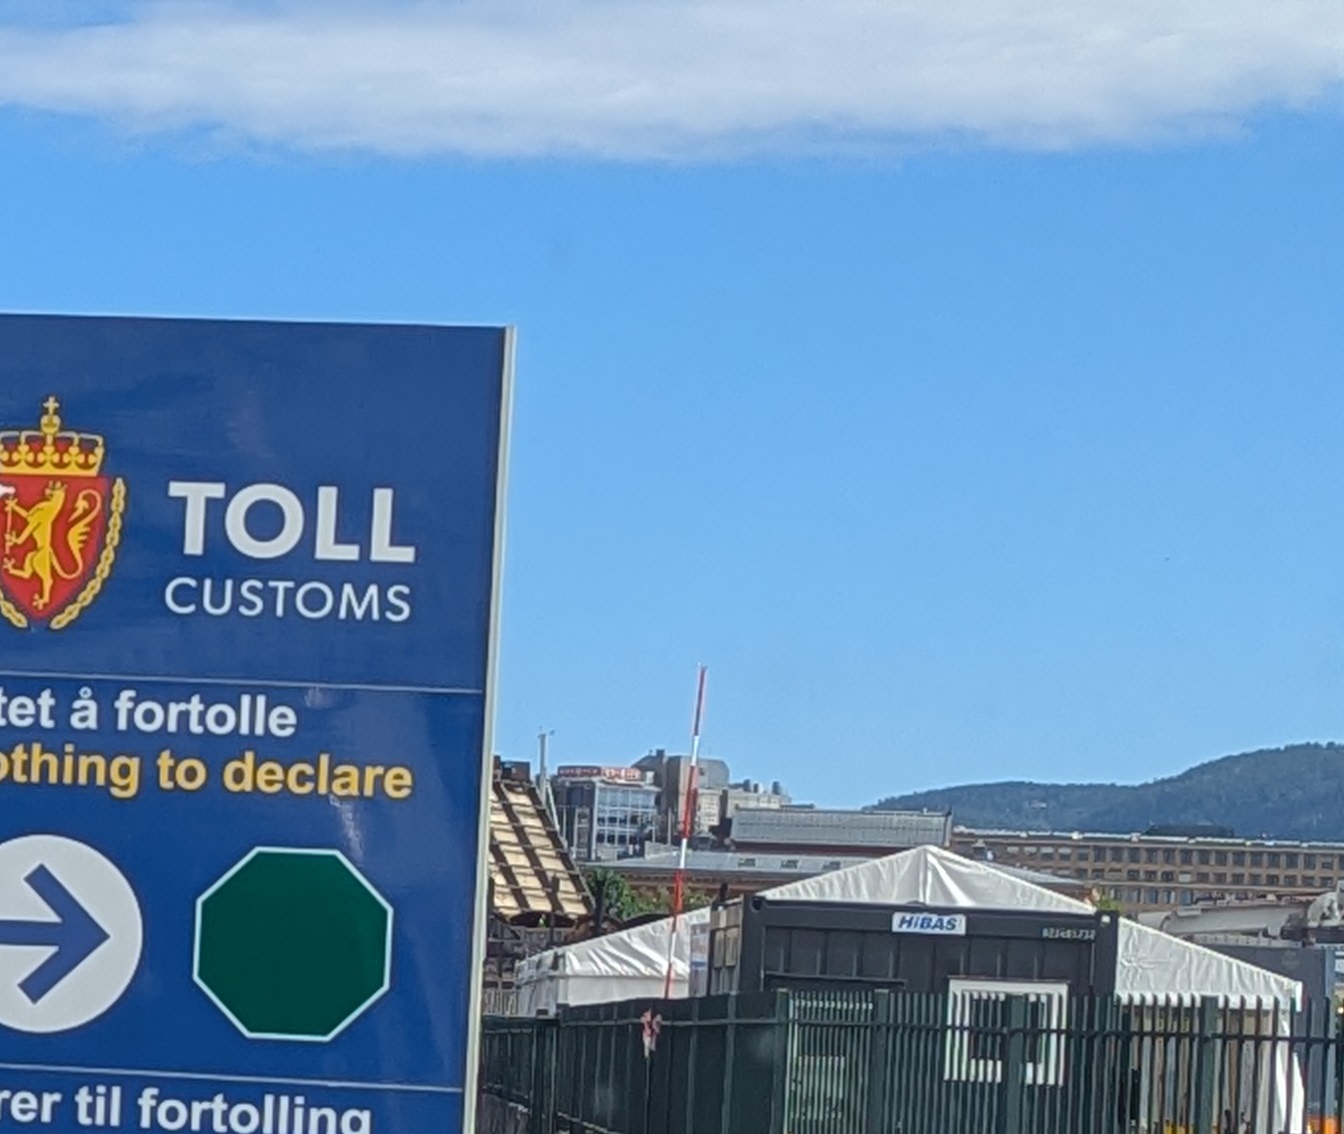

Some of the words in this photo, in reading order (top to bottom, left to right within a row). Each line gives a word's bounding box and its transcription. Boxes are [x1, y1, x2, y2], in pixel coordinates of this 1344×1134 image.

[168, 481, 415, 563] TOLL
[164, 577, 412, 623] CUSTOMS
[70, 687, 99, 732] å
[115, 690, 298, 738] fortolle
[157, 751, 206, 792] to
[223, 752, 413, 799] declare
[74, 1085, 121, 1127] til
